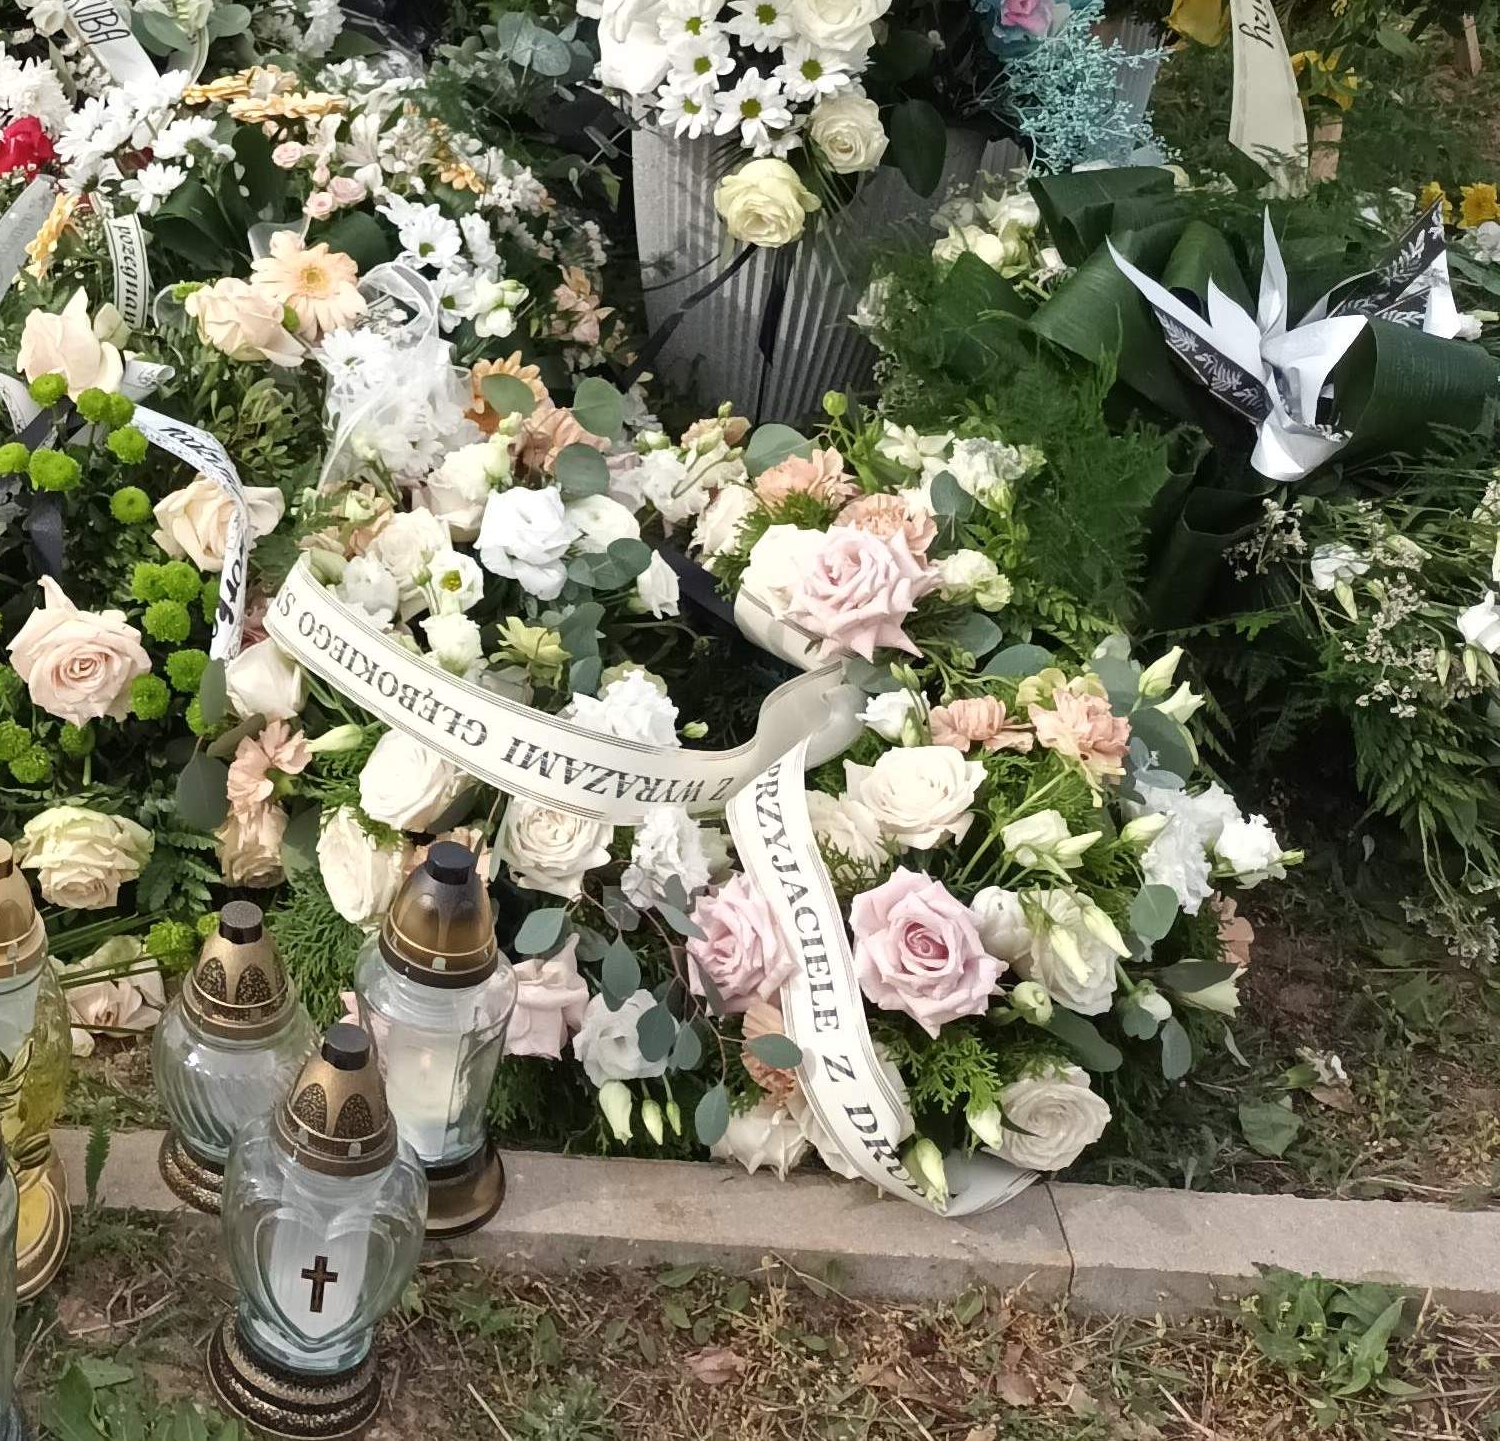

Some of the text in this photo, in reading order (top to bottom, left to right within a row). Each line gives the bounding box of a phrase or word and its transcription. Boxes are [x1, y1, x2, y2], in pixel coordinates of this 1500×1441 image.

[297, 610, 489, 749] GŁĘBOKIEGO
[502, 736, 704, 804] WYRAZAMI
[710, 775, 734, 800] Z
[754, 762, 843, 1035] PRZYJACIELE
[822, 1054, 856, 1084] Z
